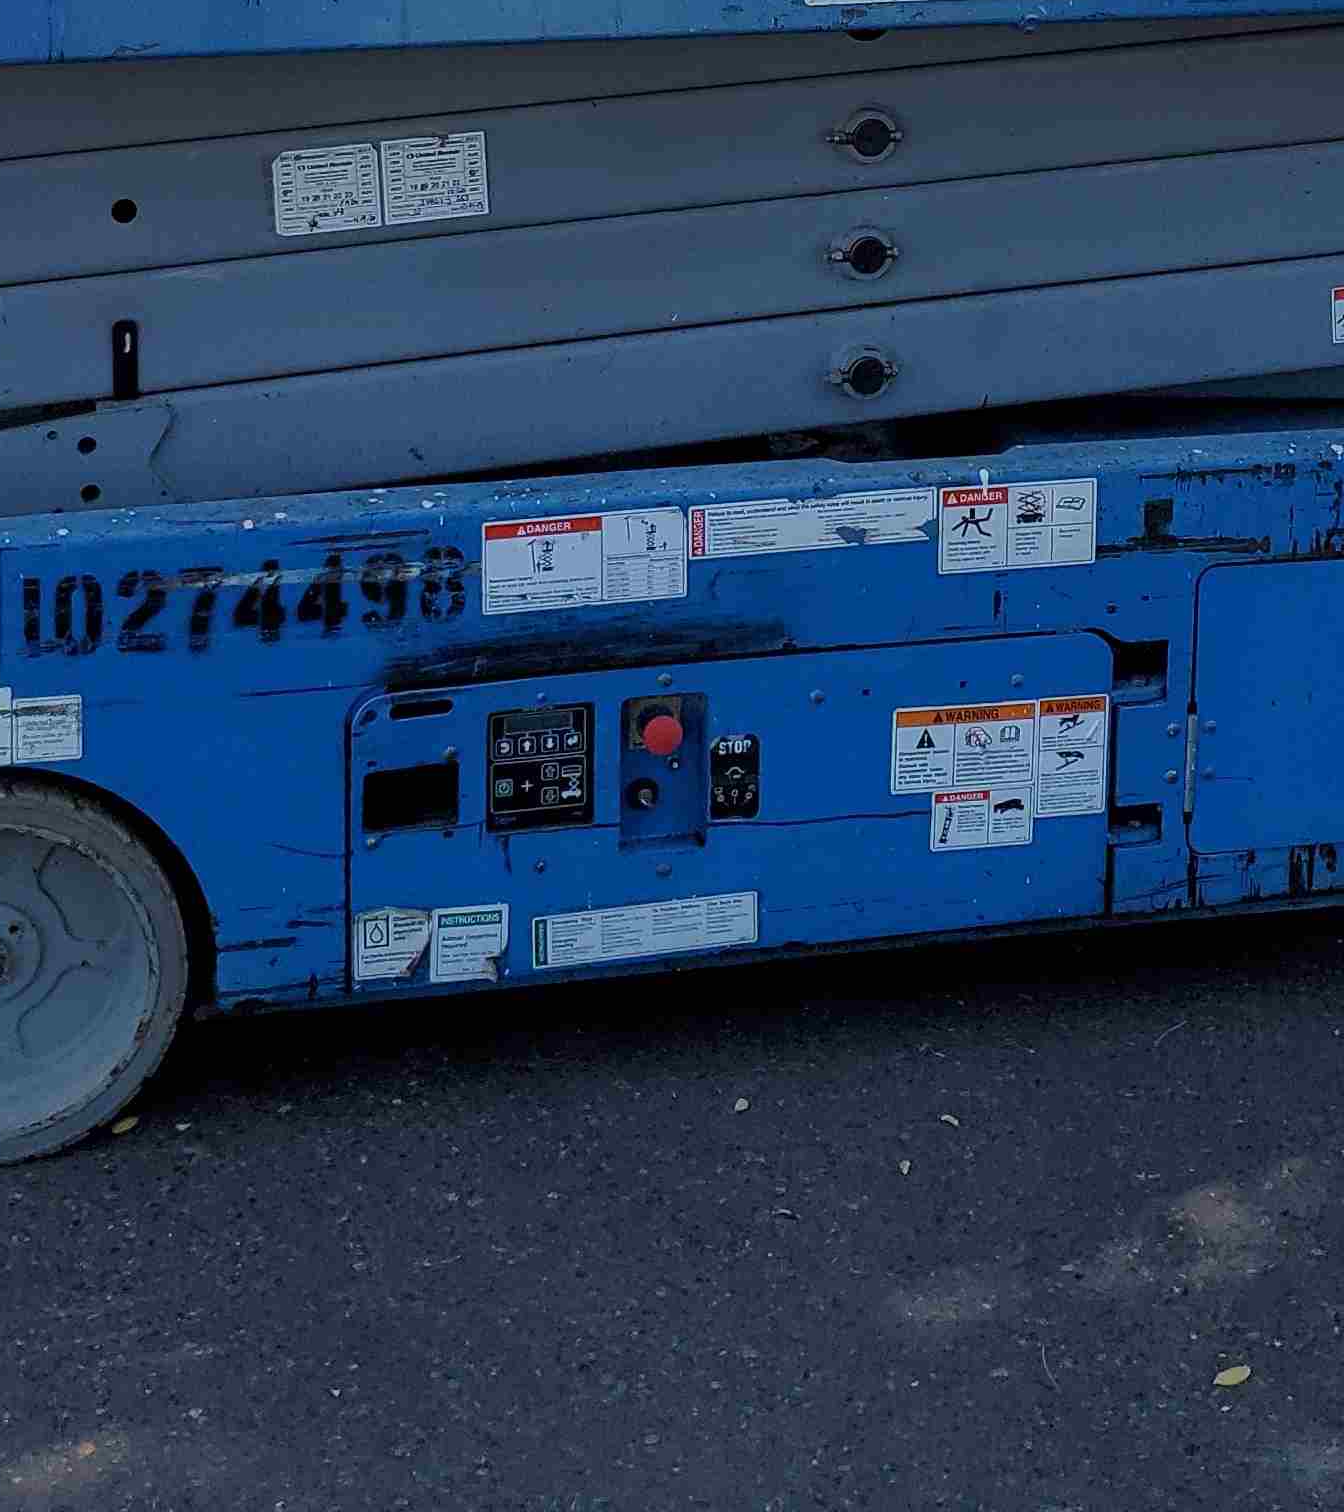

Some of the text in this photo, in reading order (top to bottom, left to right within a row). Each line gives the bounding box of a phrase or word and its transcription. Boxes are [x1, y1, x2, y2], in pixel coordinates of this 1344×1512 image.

[959, 491, 1002, 503] DANGER
[526, 521, 572, 533] DANGER
[692, 509, 705, 548] DANGER
[19, 546, 467, 657] 10274498
[1054, 699, 1102, 713] WARNING
[945, 708, 1000, 722] WARNING
[717, 738, 753, 756] STOP
[949, 791, 985, 802] DANGER
[440, 912, 500, 926] INSTRUCTIONS
